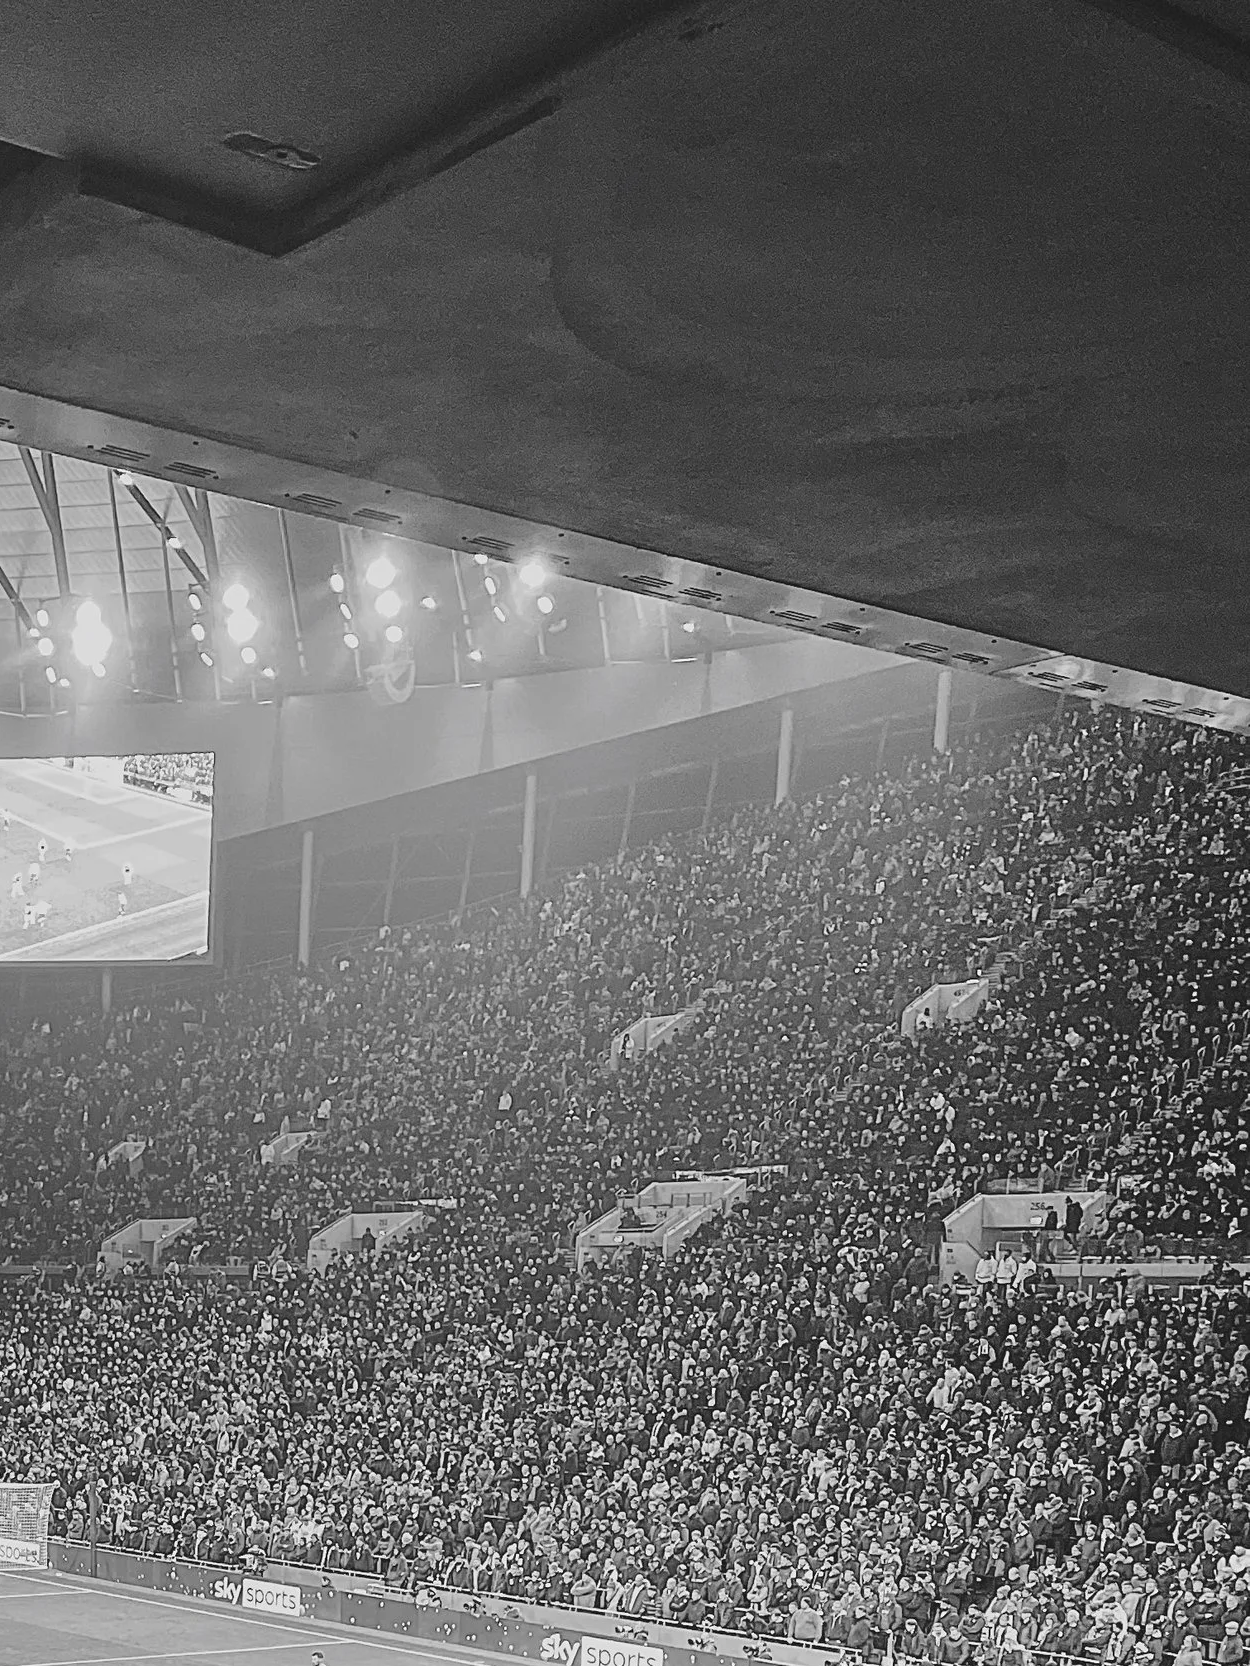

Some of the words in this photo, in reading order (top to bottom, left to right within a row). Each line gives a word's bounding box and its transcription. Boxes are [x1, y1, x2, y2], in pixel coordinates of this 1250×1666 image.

[214, 1576, 241, 1605] sky
[246, 1587, 296, 1610] sports
[540, 1633, 580, 1666] sky
